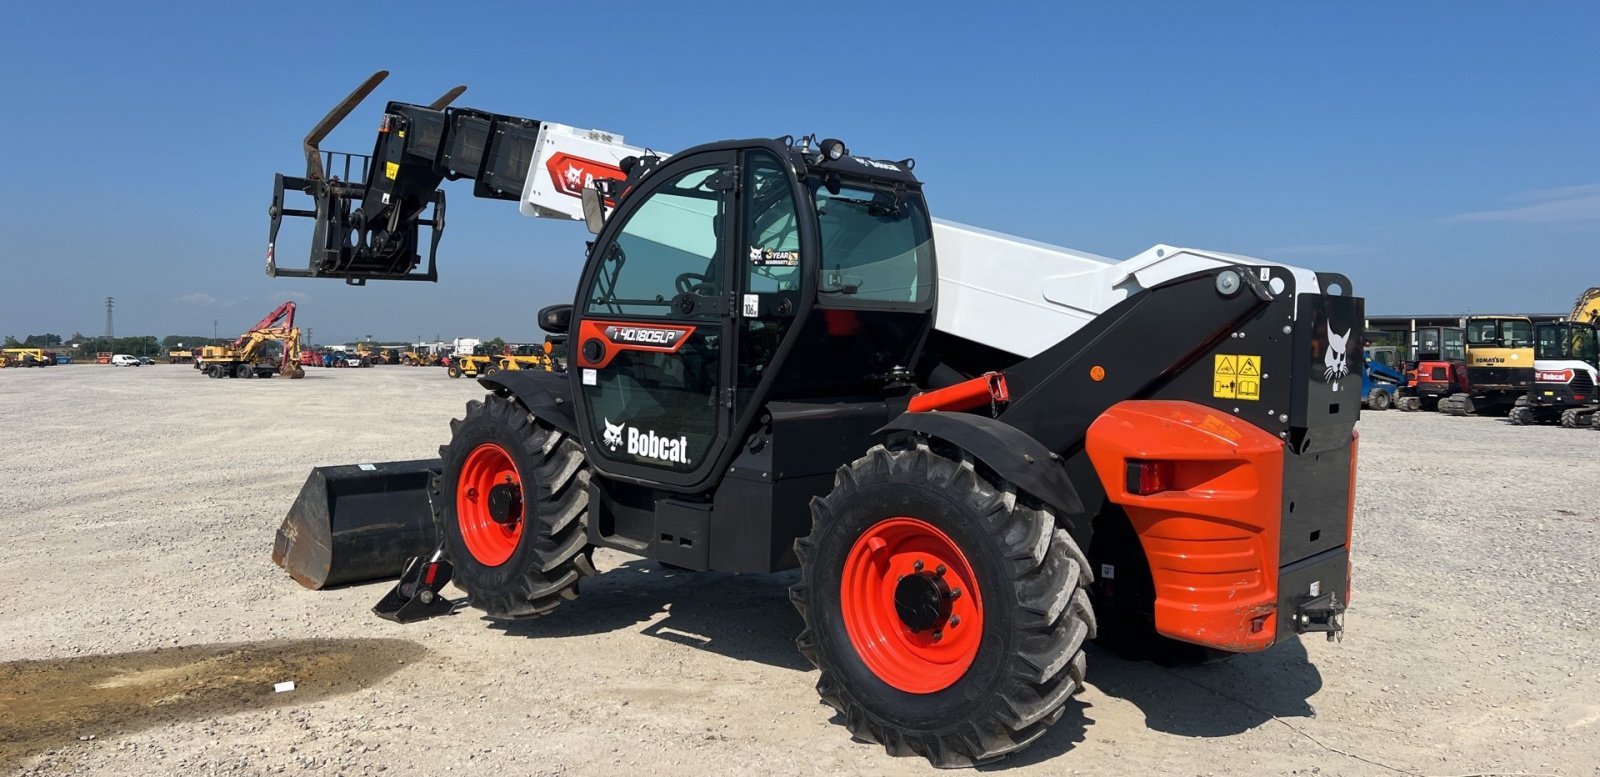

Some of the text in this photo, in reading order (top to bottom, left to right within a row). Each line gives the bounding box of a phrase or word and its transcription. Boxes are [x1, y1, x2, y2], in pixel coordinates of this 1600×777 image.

[765, 249, 788, 259] 3 YEAR
[627, 426, 688, 463] Bobcat
